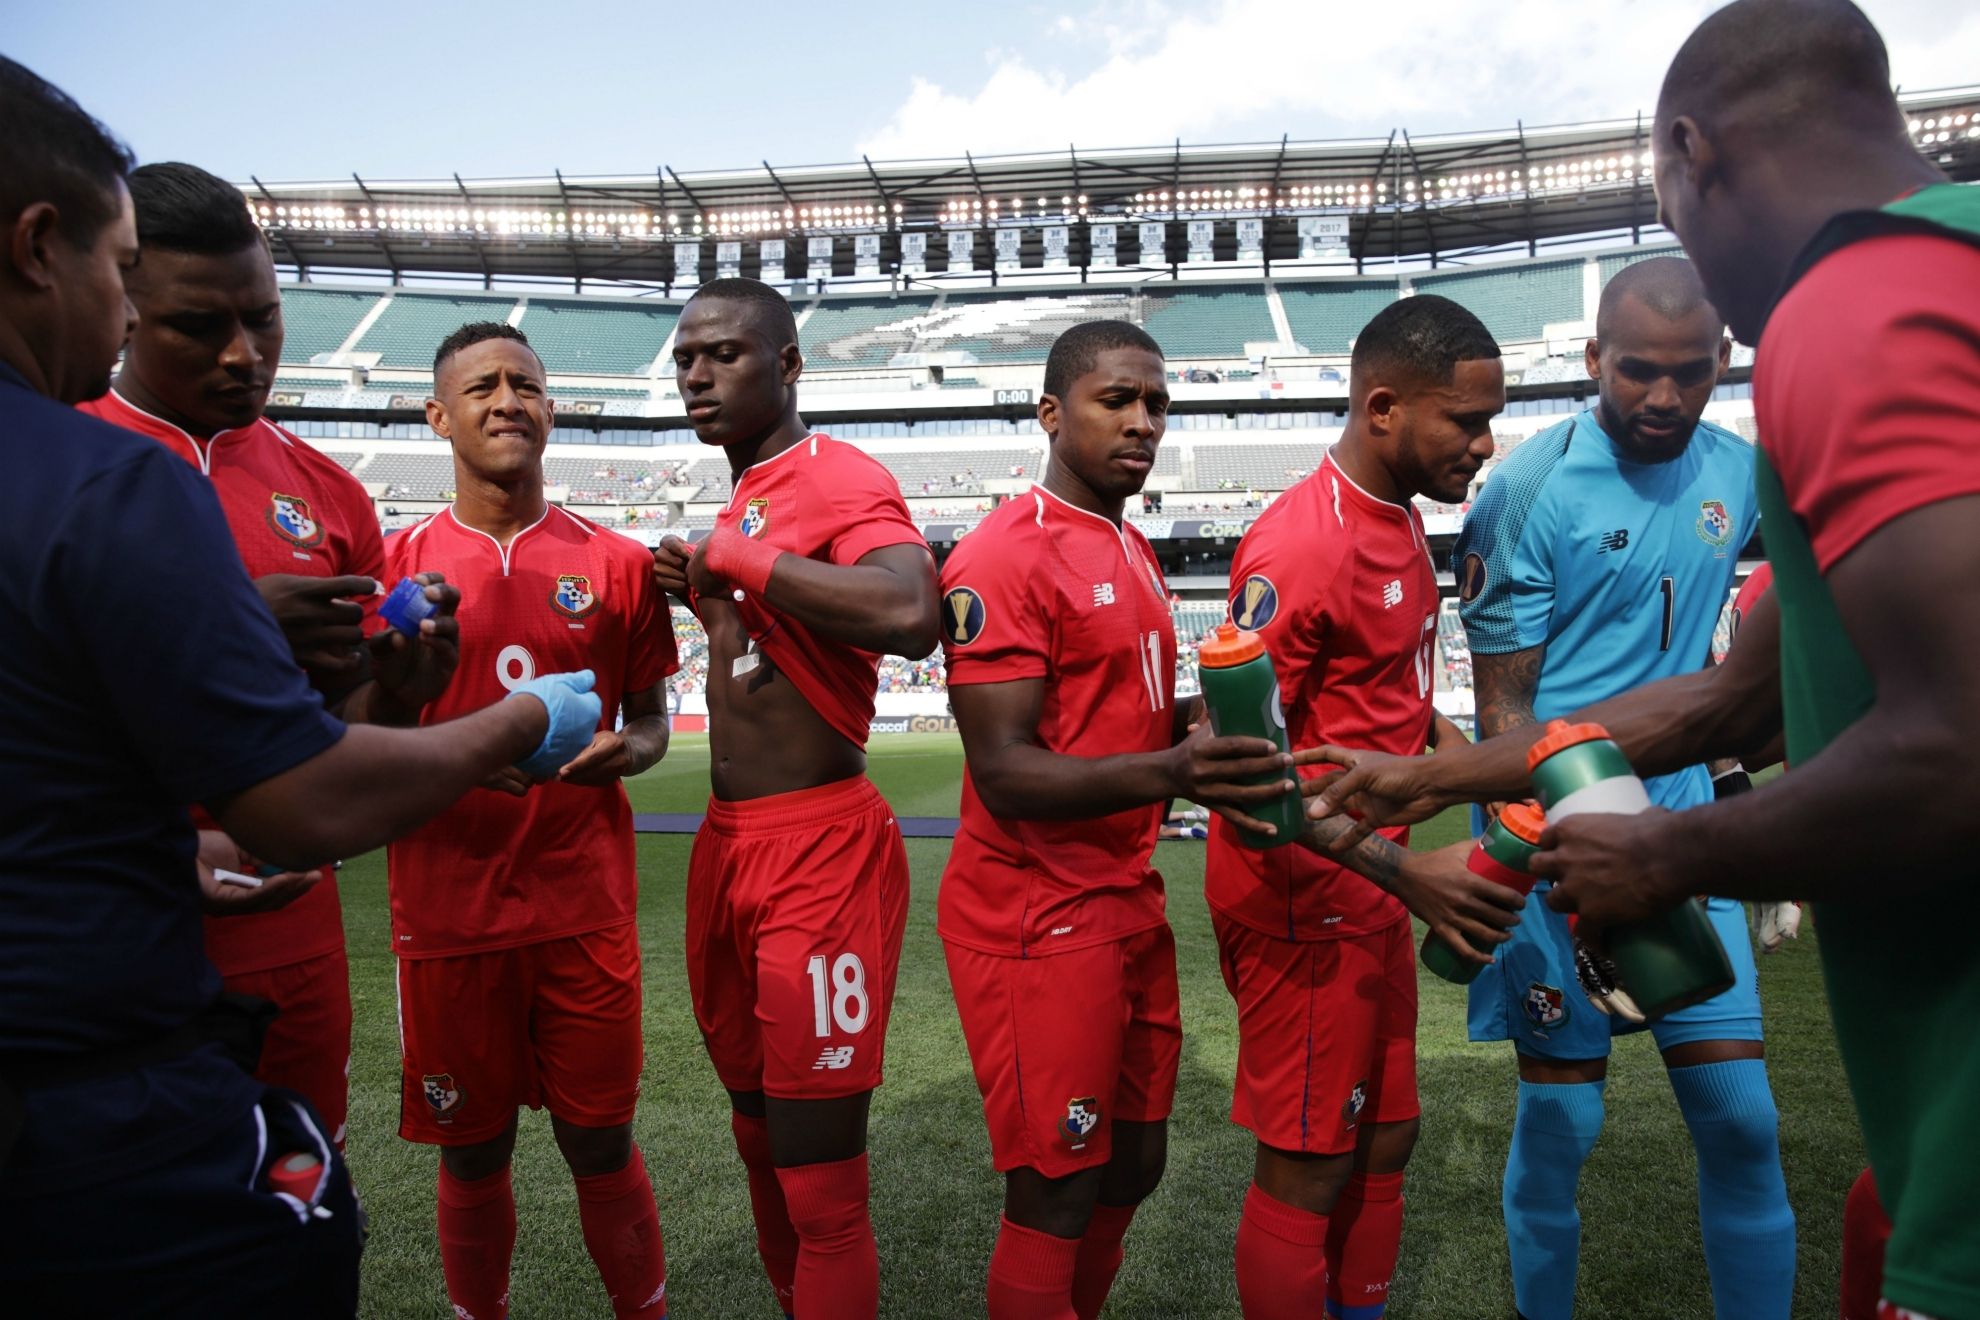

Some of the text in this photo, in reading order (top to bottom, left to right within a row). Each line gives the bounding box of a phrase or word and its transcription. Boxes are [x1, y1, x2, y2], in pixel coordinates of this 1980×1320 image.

[1319, 224, 1341, 232] 2017
[275, 394, 301, 406] CUP
[997, 390, 1028, 404] 0:00
[576, 404, 601, 415] CUP
[1199, 523, 1243, 538] COPA
[1660, 576, 1674, 652] 1
[807, 952, 869, 1037] 18
